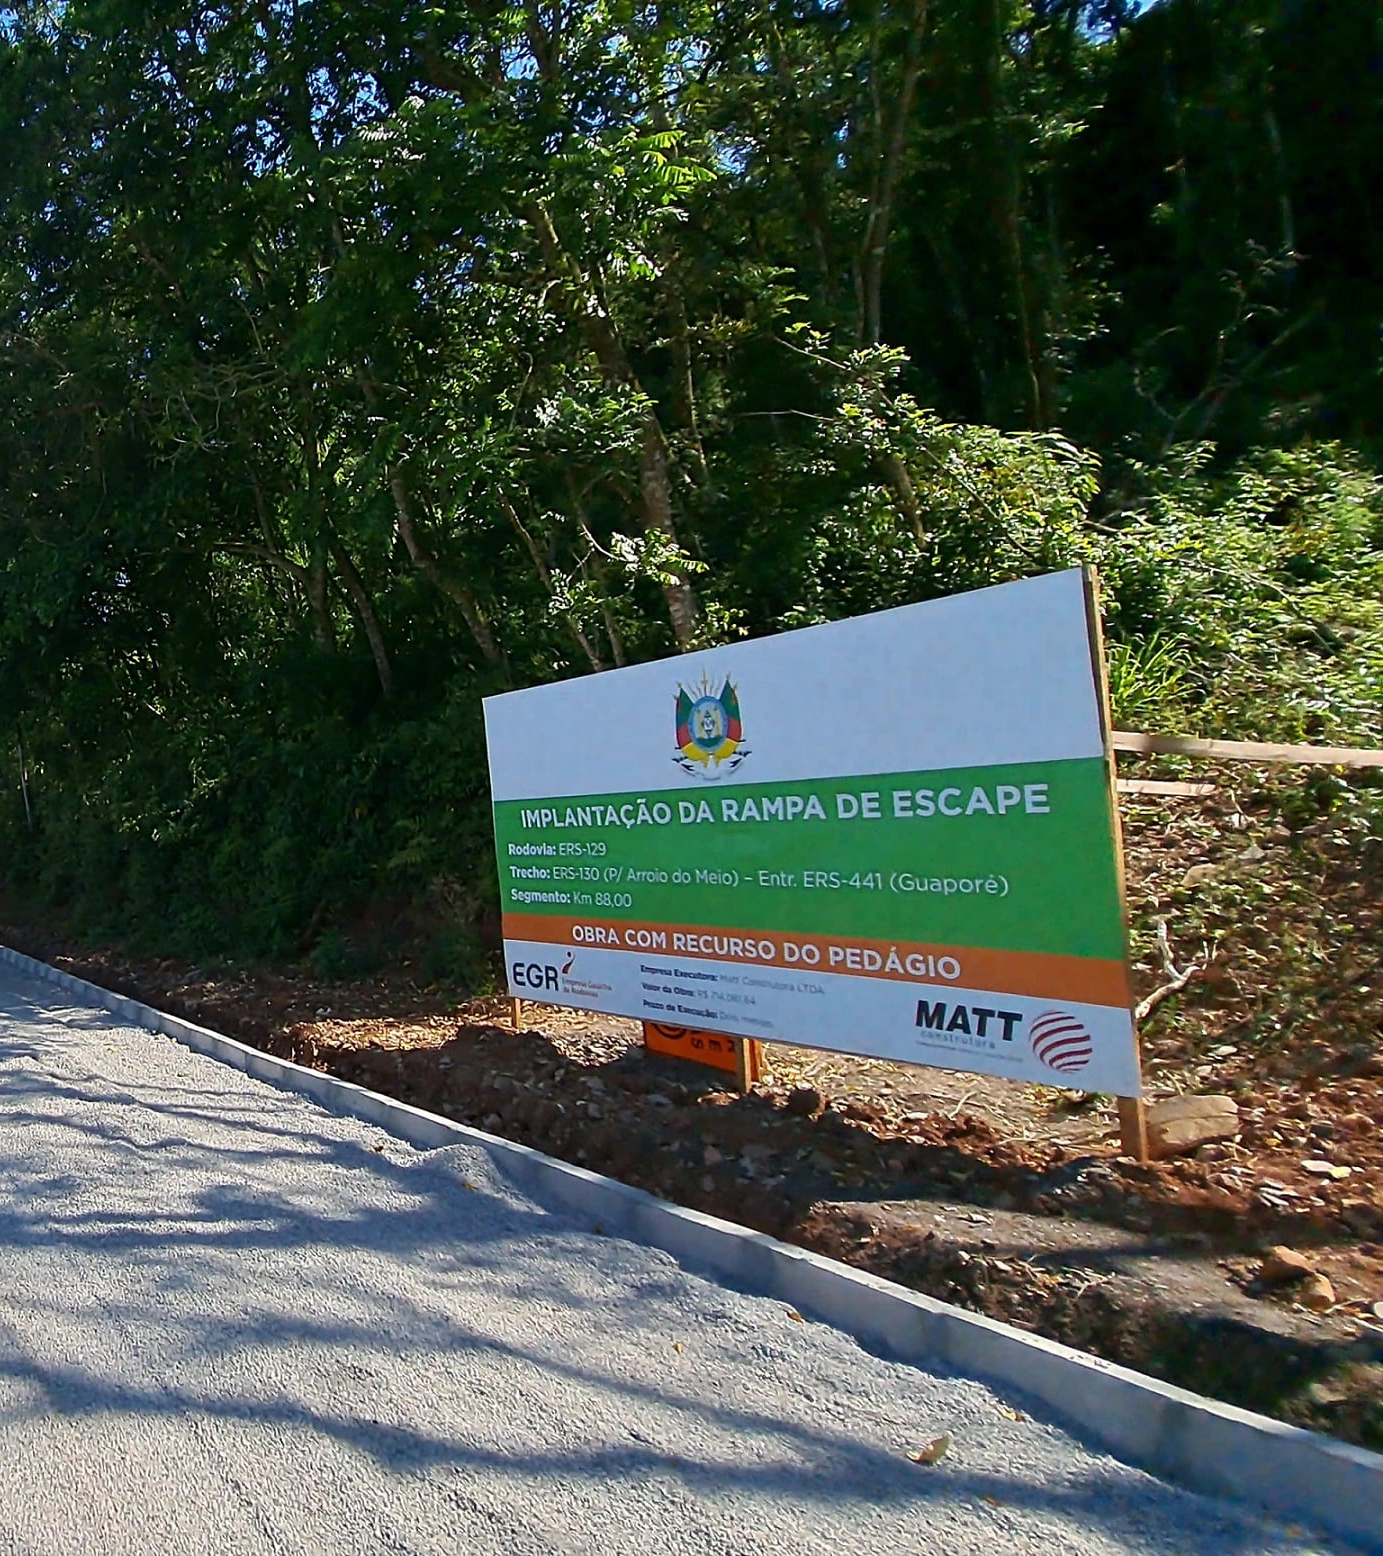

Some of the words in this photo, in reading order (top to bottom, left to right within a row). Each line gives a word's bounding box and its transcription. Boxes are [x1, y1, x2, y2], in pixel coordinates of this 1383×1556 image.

[520, 798, 672, 829] IMPLANTAÇÃO
[678, 800, 715, 825] DA
[721, 794, 827, 823] RAMPA
[835, 791, 882, 819] DE
[892, 783, 1051, 818] ESCAPE
[508, 842, 557, 856] Rodovia:
[558, 842, 607, 857] ERS-129
[509, 865, 551, 880] Trecho:
[552, 866, 600, 881] ERS-130
[603, 867, 623, 884] (P/
[627, 868, 668, 883] Arroio
[672, 868, 691, 883] do
[695, 869, 739, 888] Meio)
[758, 870, 797, 887] Entr.
[803, 871, 883, 890] ERS-441
[889, 872, 1010, 897] (Guaporé)
[510, 888, 571, 905] Segmento:
[573, 892, 592, 905] Km
[594, 893, 632, 908] 88,00
[571, 924, 620, 945] OBRA
[625, 929, 667, 949] COM
[673, 932, 776, 960] RECURSO
[783, 942, 821, 965] DO
[828, 946, 962, 980] PEDÁGIO
[512, 962, 559, 992] EGR
[640, 964, 672, 977] Empresa
[674, 969, 718, 982] Executora:
[641, 982, 661, 992] Valor
[662, 985, 672, 993] da
[665, 1004, 676, 1012] de
[915, 999, 1023, 1042] MATT
[920, 1030, 997, 1050] construtora
